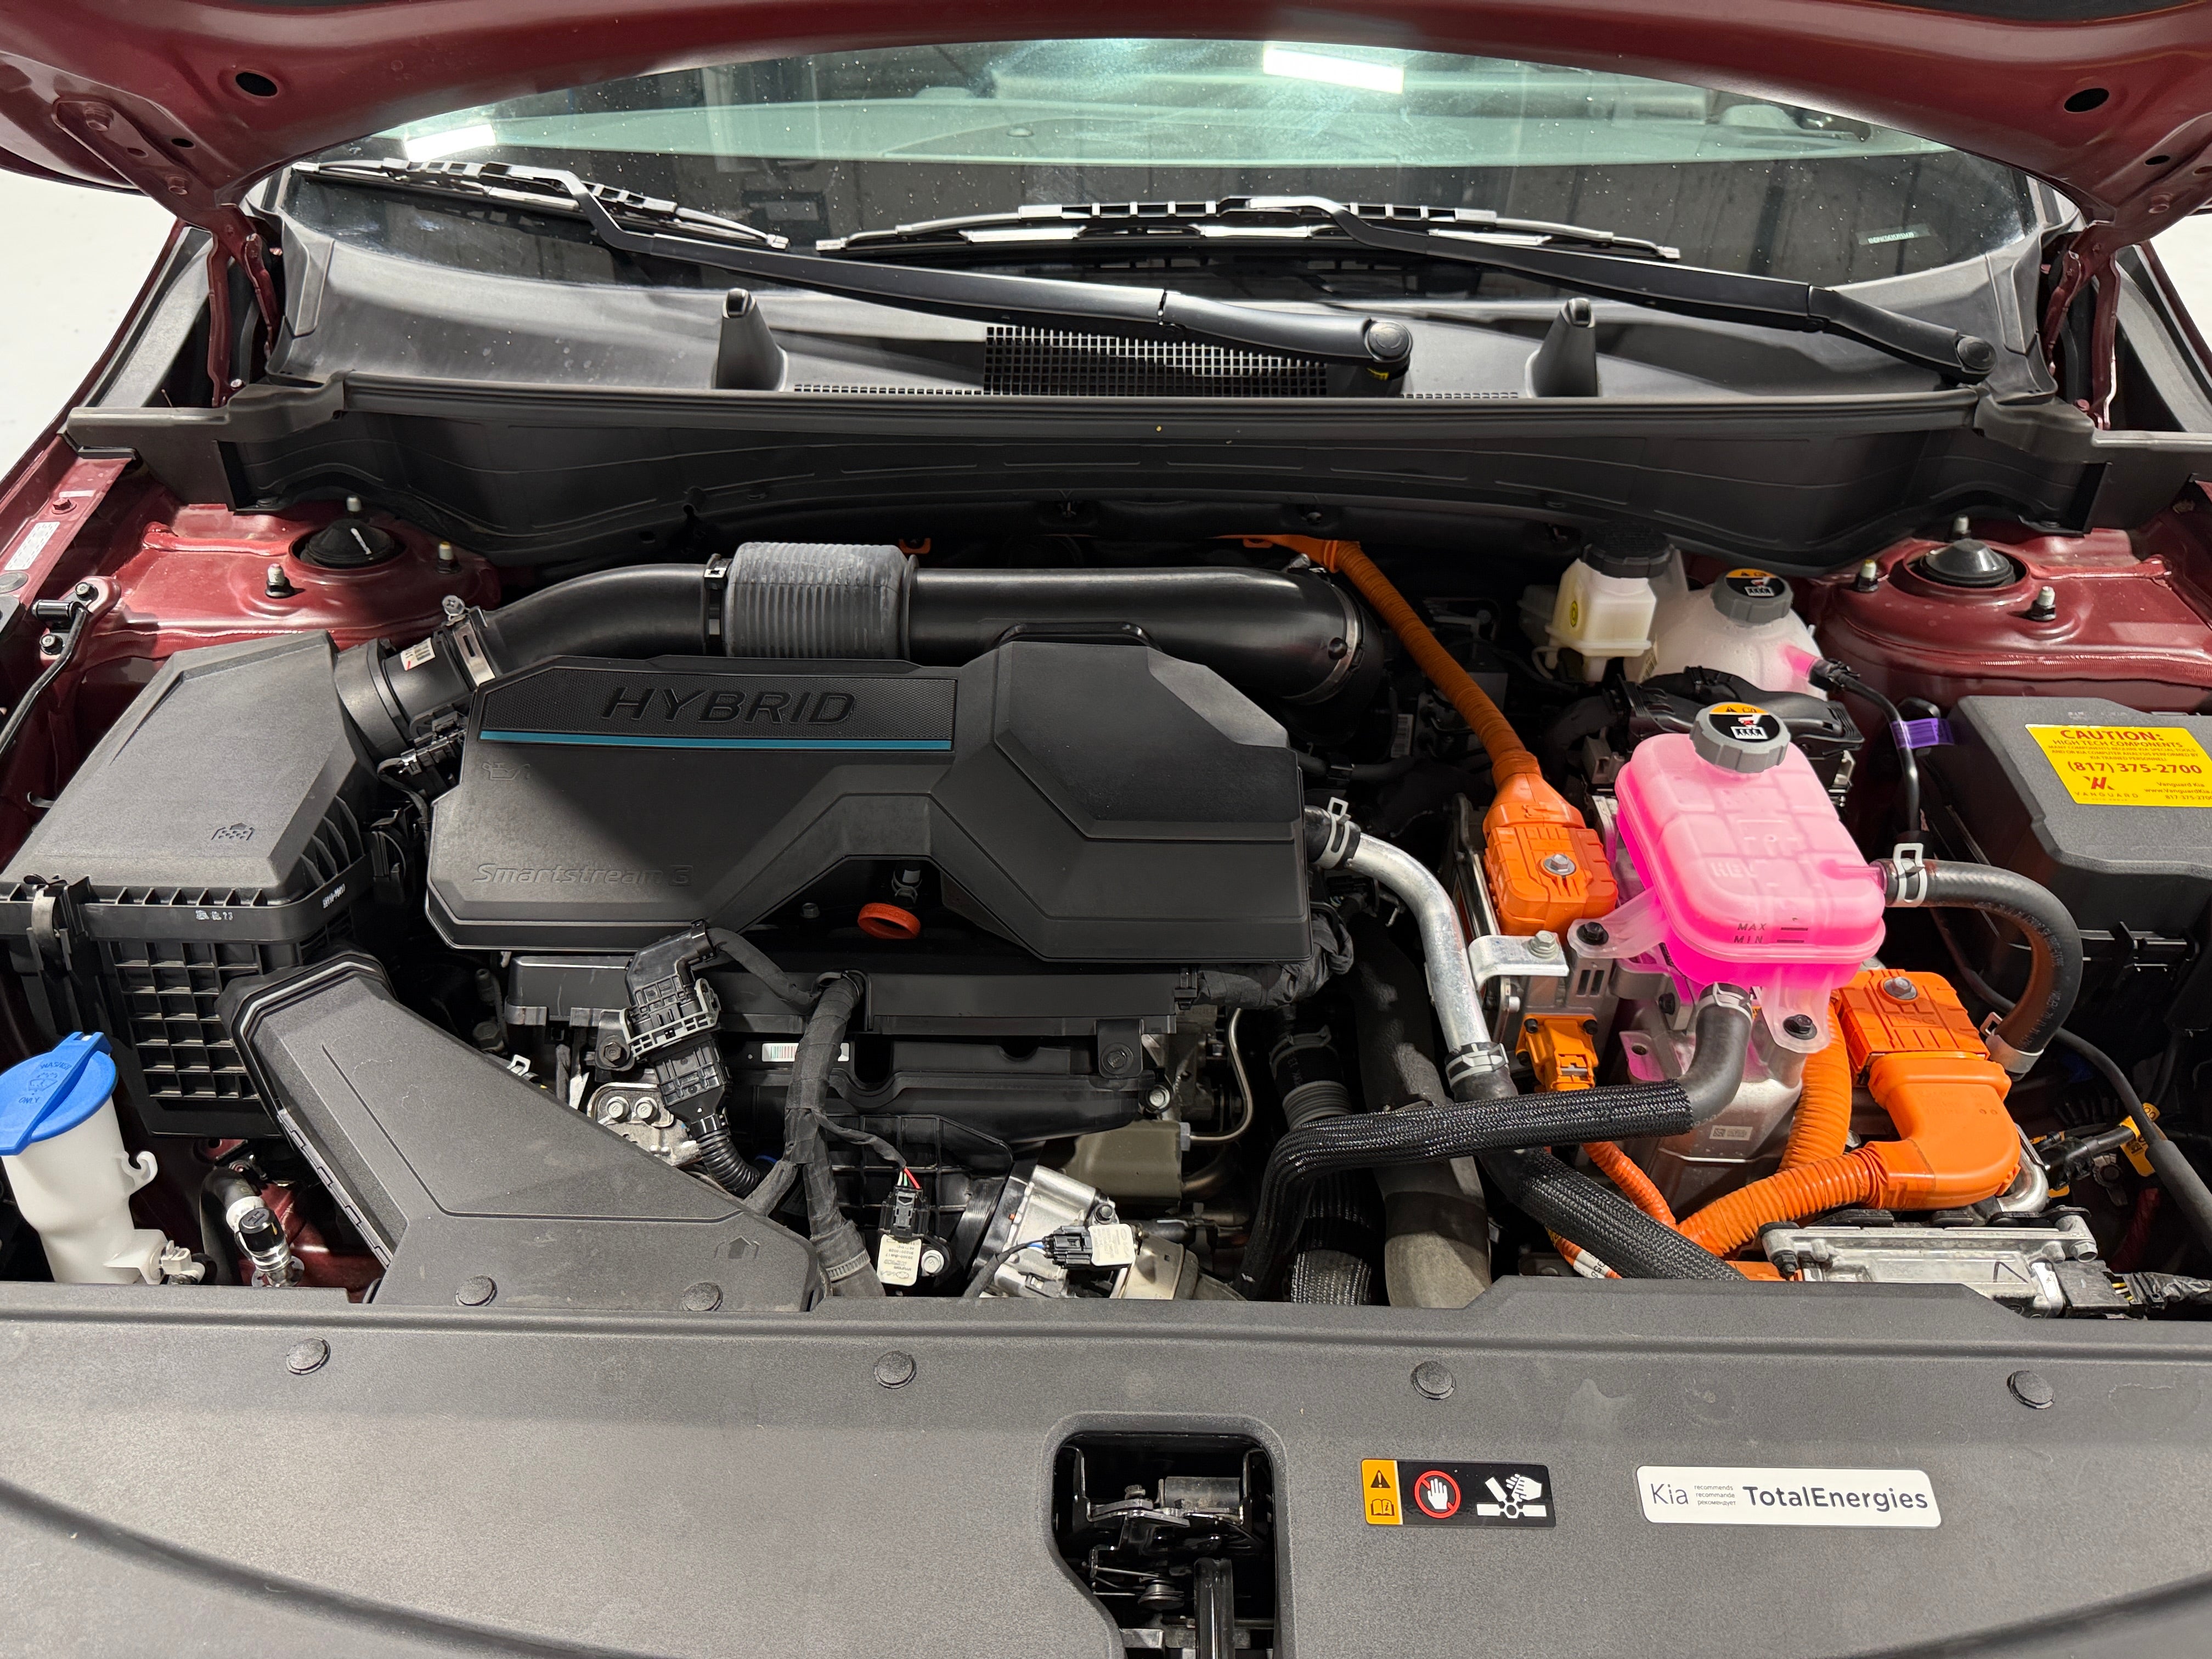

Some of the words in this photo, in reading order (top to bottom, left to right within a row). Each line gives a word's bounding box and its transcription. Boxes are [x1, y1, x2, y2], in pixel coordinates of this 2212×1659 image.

[603, 687, 856, 724] HYBRID
[2061, 730, 2164, 741] CAUTION:
[2068, 761, 2114, 773] (817)
[2117, 763, 2202, 774] 375-2700
[472, 862, 663, 885] Smartstream
[1734, 935, 1763, 944] MIN
[40, 1062, 72, 1070] WASHER
[1650, 1483, 1689, 1505] Kia
[1742, 1486, 1928, 1513] TotalEnergies
